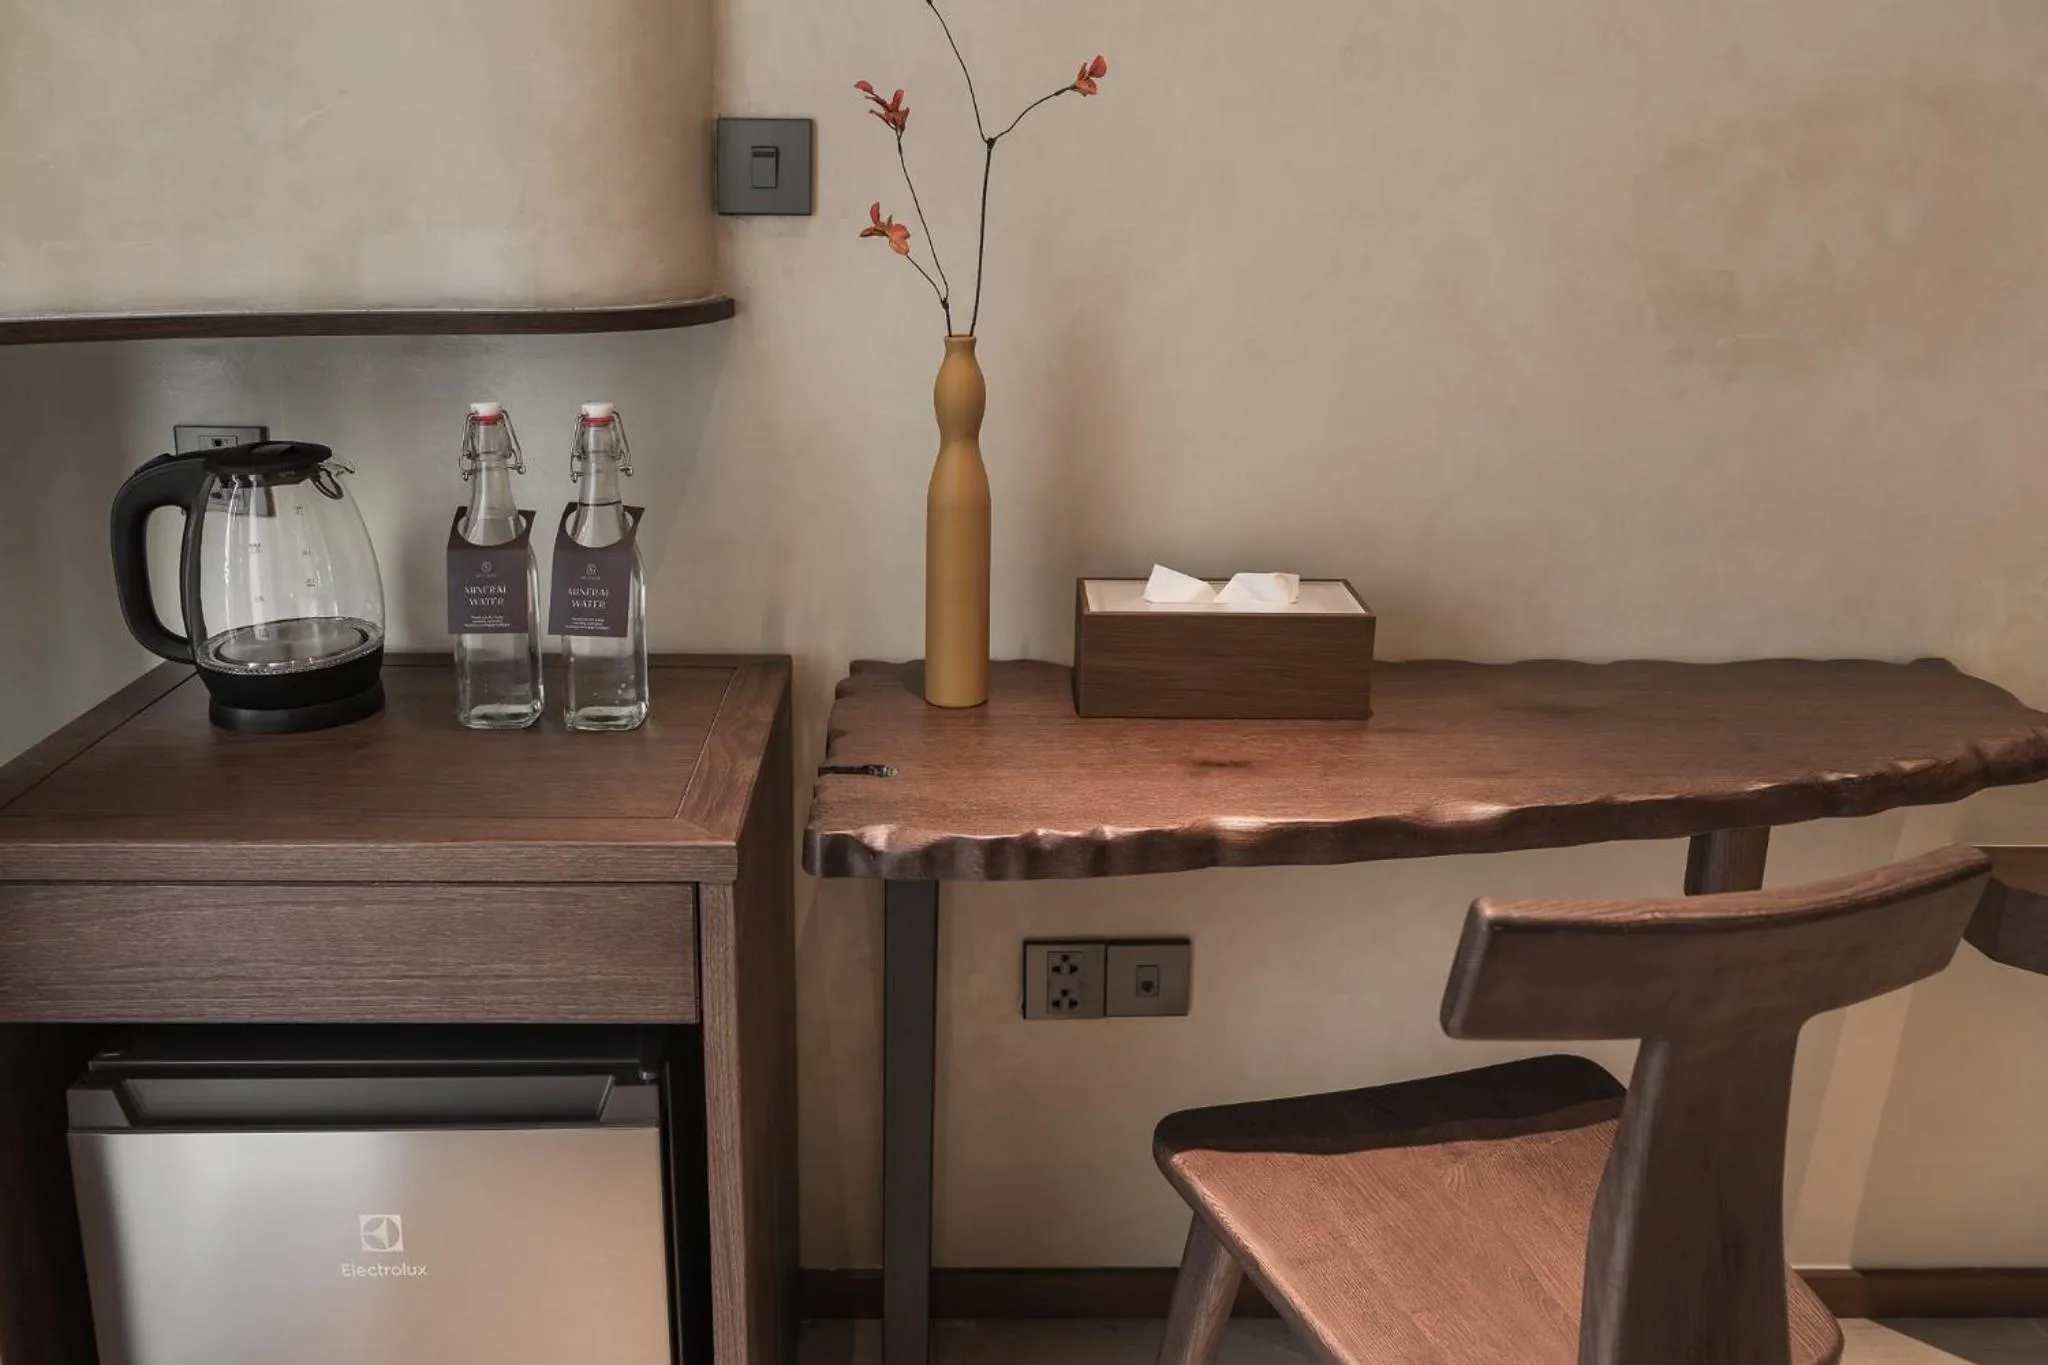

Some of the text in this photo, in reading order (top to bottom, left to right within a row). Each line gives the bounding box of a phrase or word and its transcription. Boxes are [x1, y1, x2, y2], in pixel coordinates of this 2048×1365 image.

[464, 585, 507, 595] MINERAL
[469, 597, 505, 606] WATER
[572, 599, 606, 608] WATER
[341, 1261, 428, 1278] Electrolux
